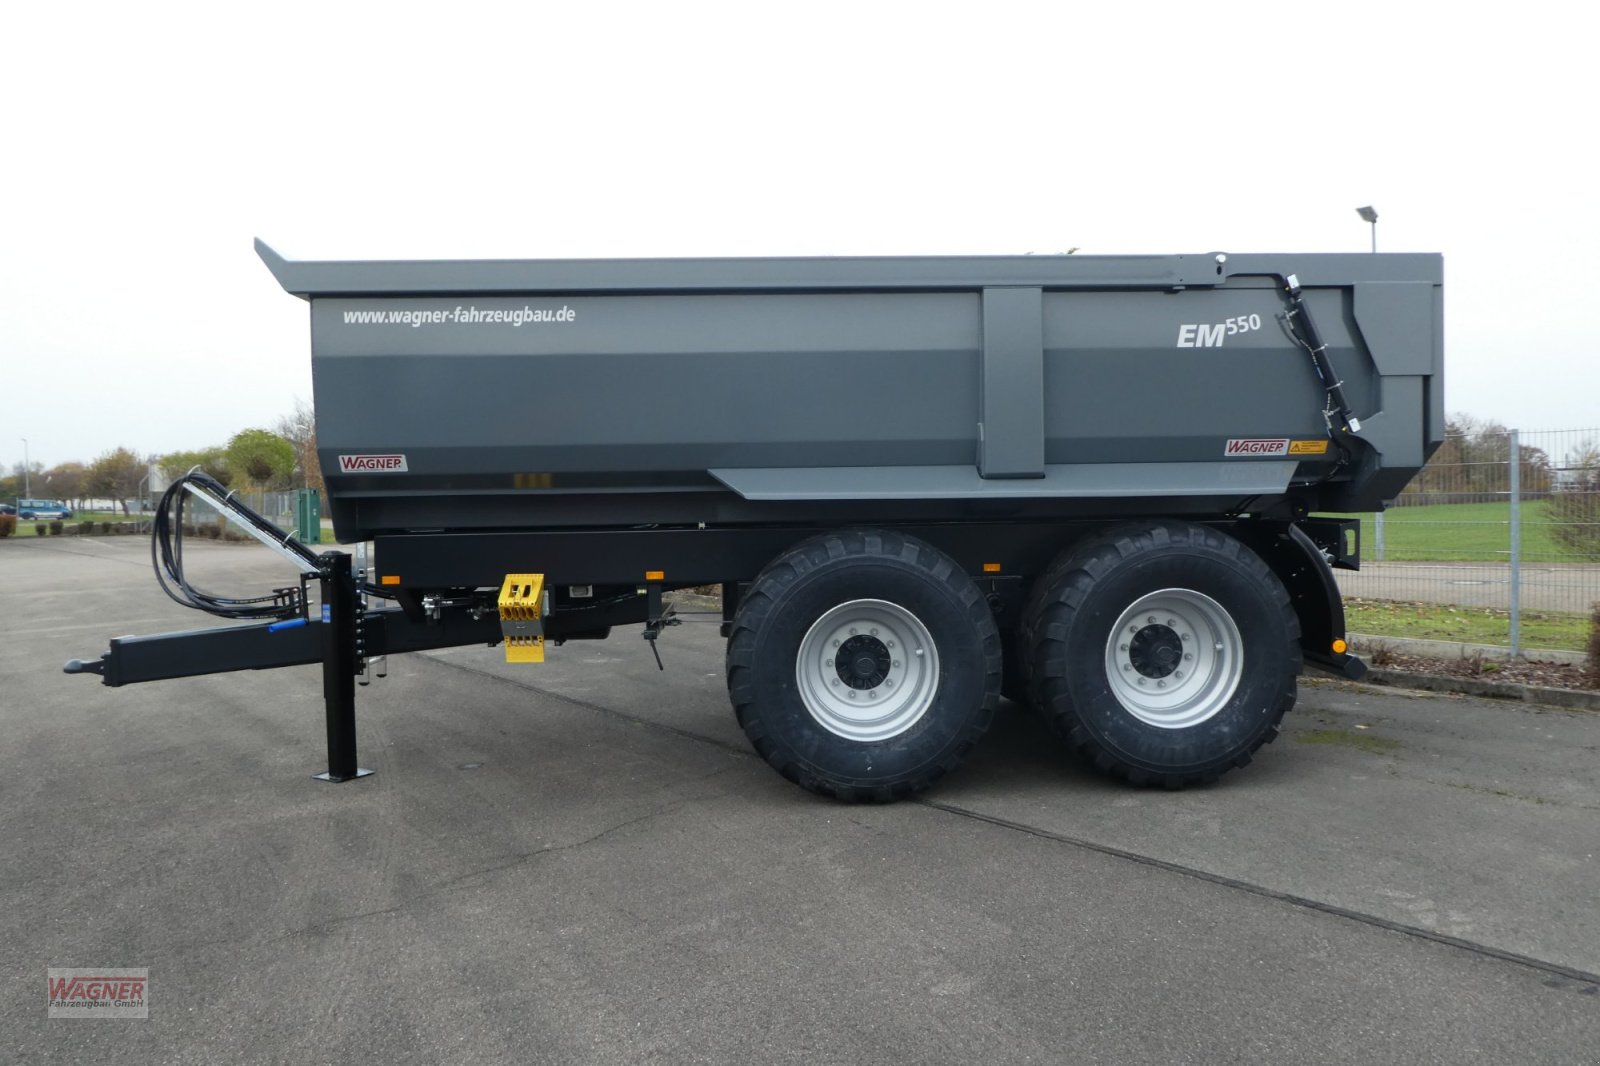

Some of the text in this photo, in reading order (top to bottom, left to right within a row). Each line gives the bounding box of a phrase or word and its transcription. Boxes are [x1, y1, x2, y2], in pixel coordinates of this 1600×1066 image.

[343, 306, 576, 327] www.wagner-fahrzeugbau.de
[1228, 440, 1286, 453] WAGNER
[341, 456, 402, 470] WAGNER
